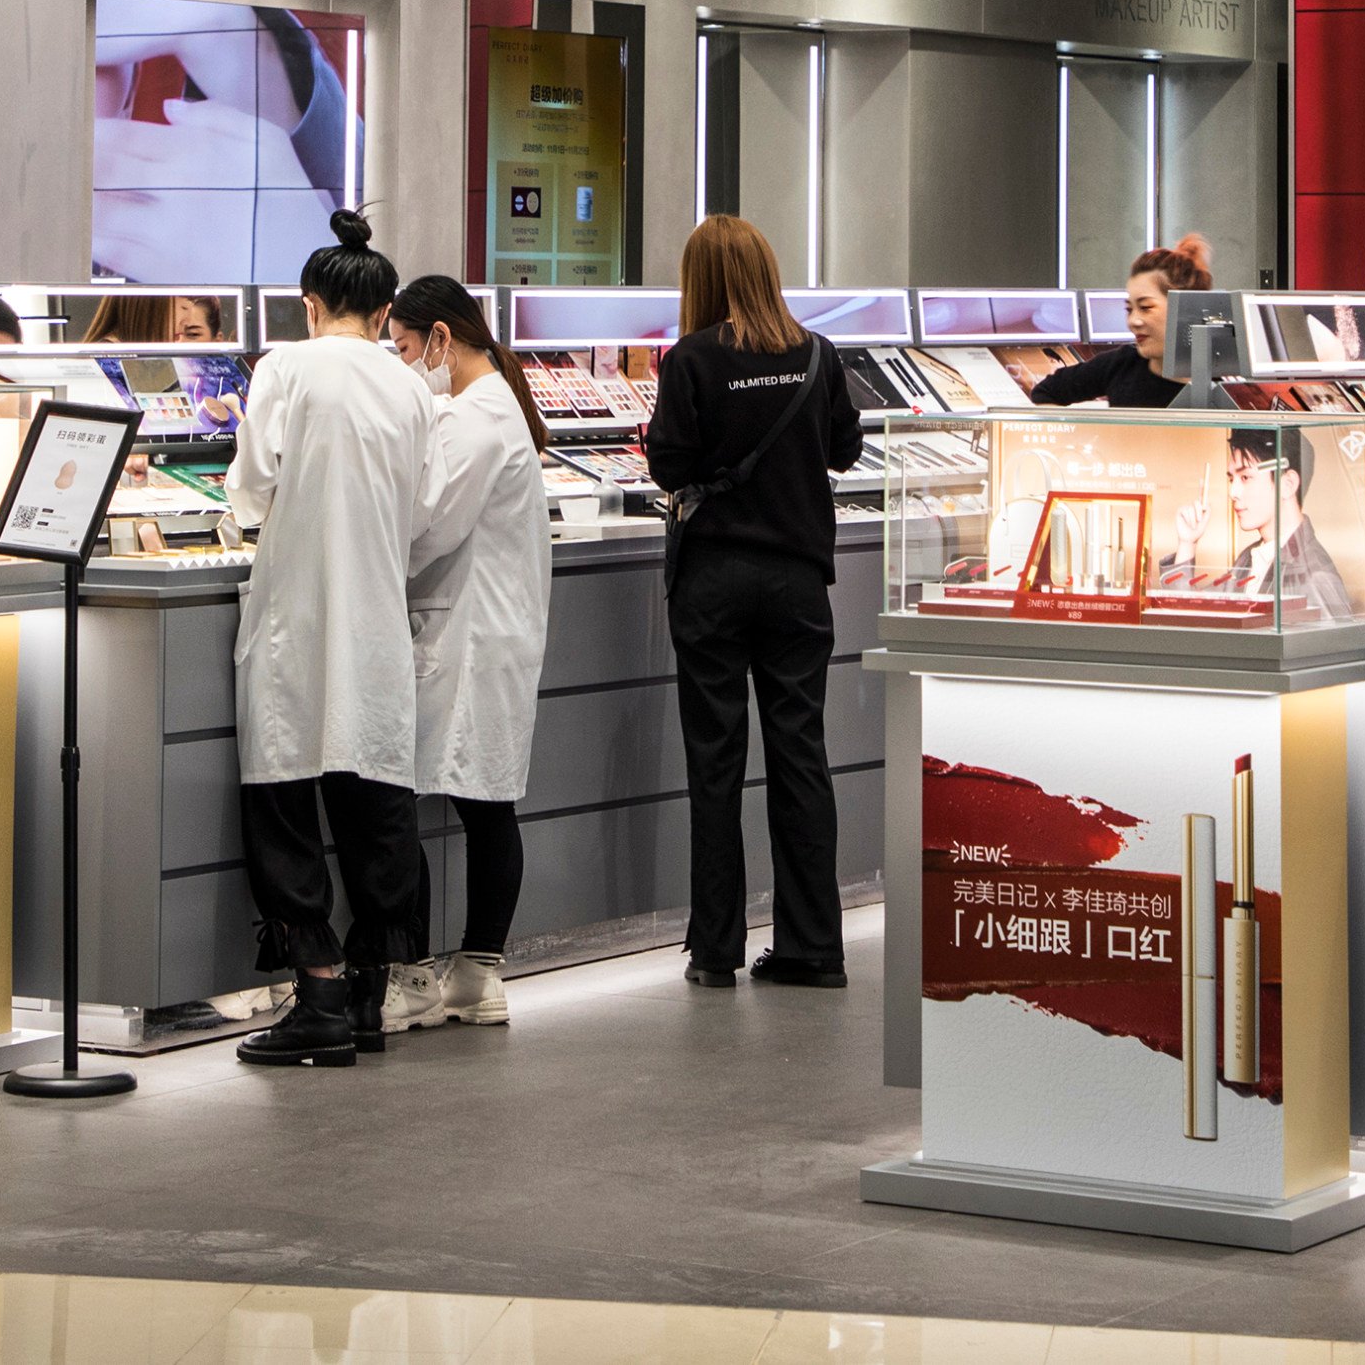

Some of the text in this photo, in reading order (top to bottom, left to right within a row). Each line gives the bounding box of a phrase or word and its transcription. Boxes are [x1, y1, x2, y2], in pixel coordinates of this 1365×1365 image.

[728, 376, 778, 390] UNLIMITED
[1002, 422, 1076, 433] PERFECT DIARY
[1031, 599, 1051, 608] NEW
[960, 844, 1002, 864] NEW
[953, 878, 1038, 909] 完美日记
[1062, 887, 1172, 920] 李佳琦共创
